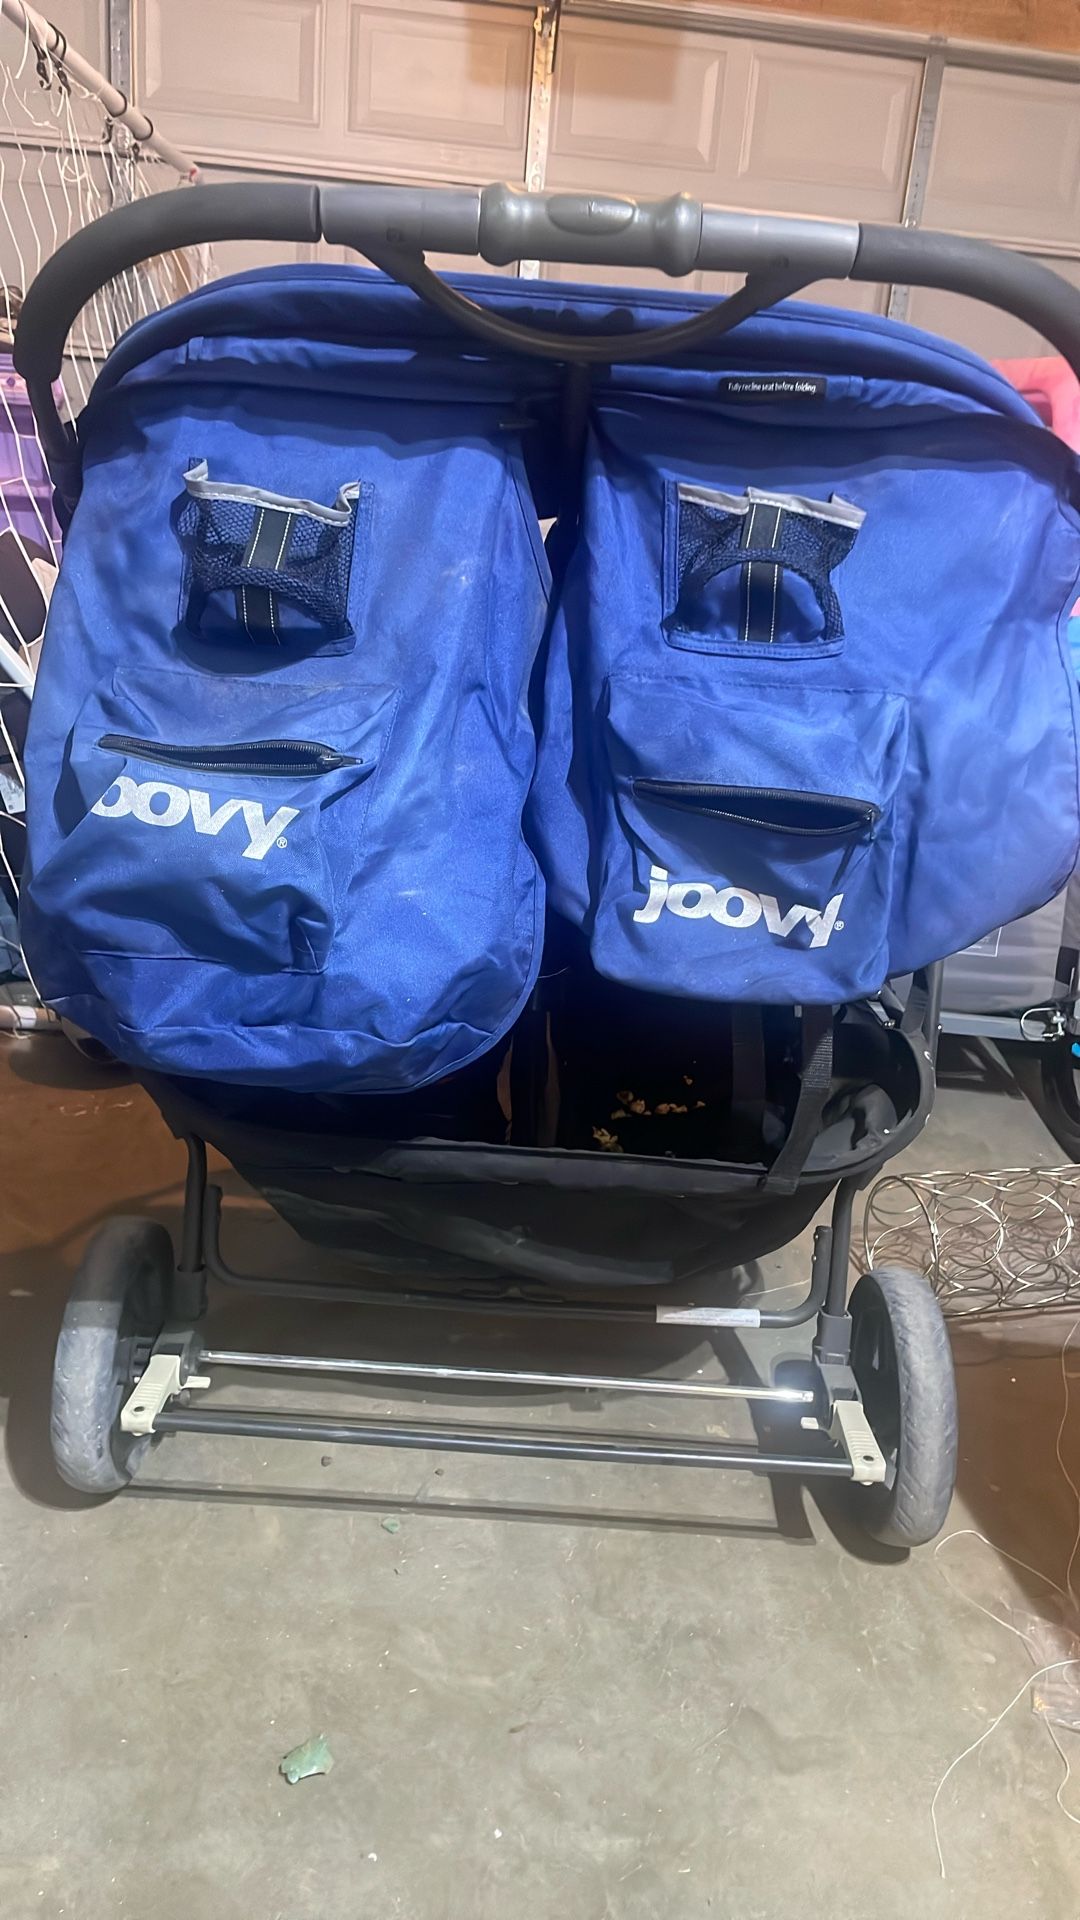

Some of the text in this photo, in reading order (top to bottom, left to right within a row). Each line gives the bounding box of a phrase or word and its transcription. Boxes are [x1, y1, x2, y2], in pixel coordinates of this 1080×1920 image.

[741, 382, 761, 391] recline
[762, 382, 774, 391] seat
[775, 381, 794, 392] before
[795, 382, 816, 395] folding
